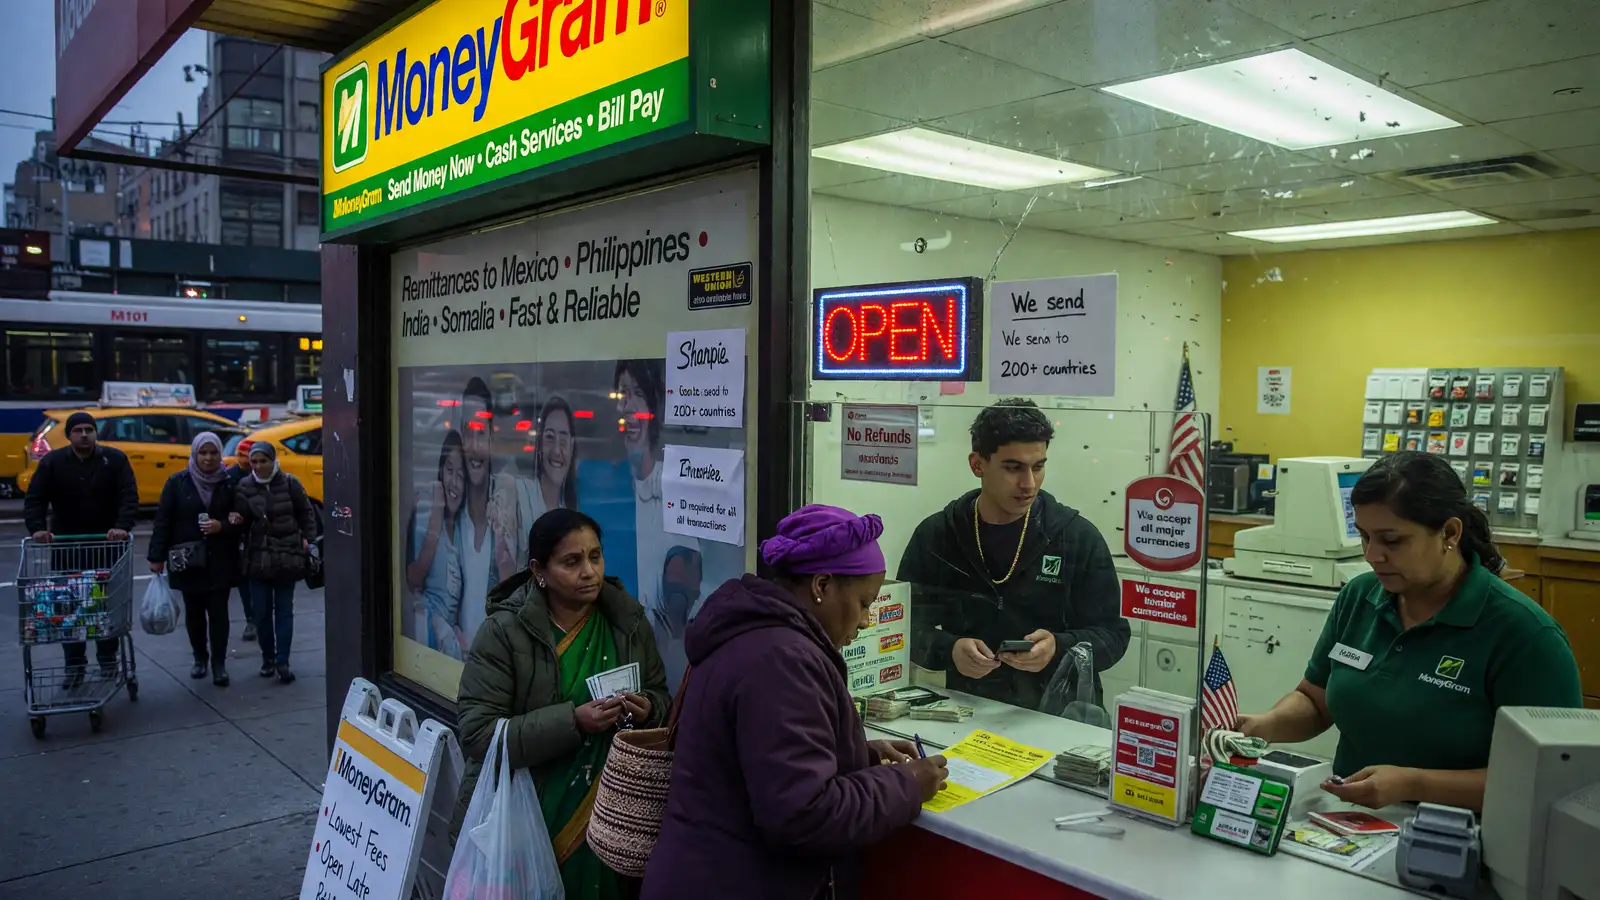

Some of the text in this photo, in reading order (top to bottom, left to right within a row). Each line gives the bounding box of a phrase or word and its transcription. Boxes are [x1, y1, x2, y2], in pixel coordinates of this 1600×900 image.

[387, 88, 664, 201] Send Money Now Cash Services Bill Pay
[402, 230, 690, 302] Remittances to Mexico Philippines
[402, 282, 641, 337] India Somalia Fast & Reliable
[1011, 287, 1085, 314] We send
[111, 310, 148, 322] M101
[823, 297, 956, 363] OPEN
[1002, 330, 1021, 346] We
[1056, 331, 1069, 344] to
[1001, 359, 1097, 378] 200+ countries
[674, 404, 736, 417] 200+ countries
[847, 427, 912, 444] No Refunds
[1137, 510, 1192, 526] We accept
[1135, 536, 1191, 550] currencies
[1418, 672, 1471, 695] MoneyGram
[328, 801, 388, 872] Lowest Fees
[320, 840, 344, 880] Open
[346, 861, 370, 900] Late
